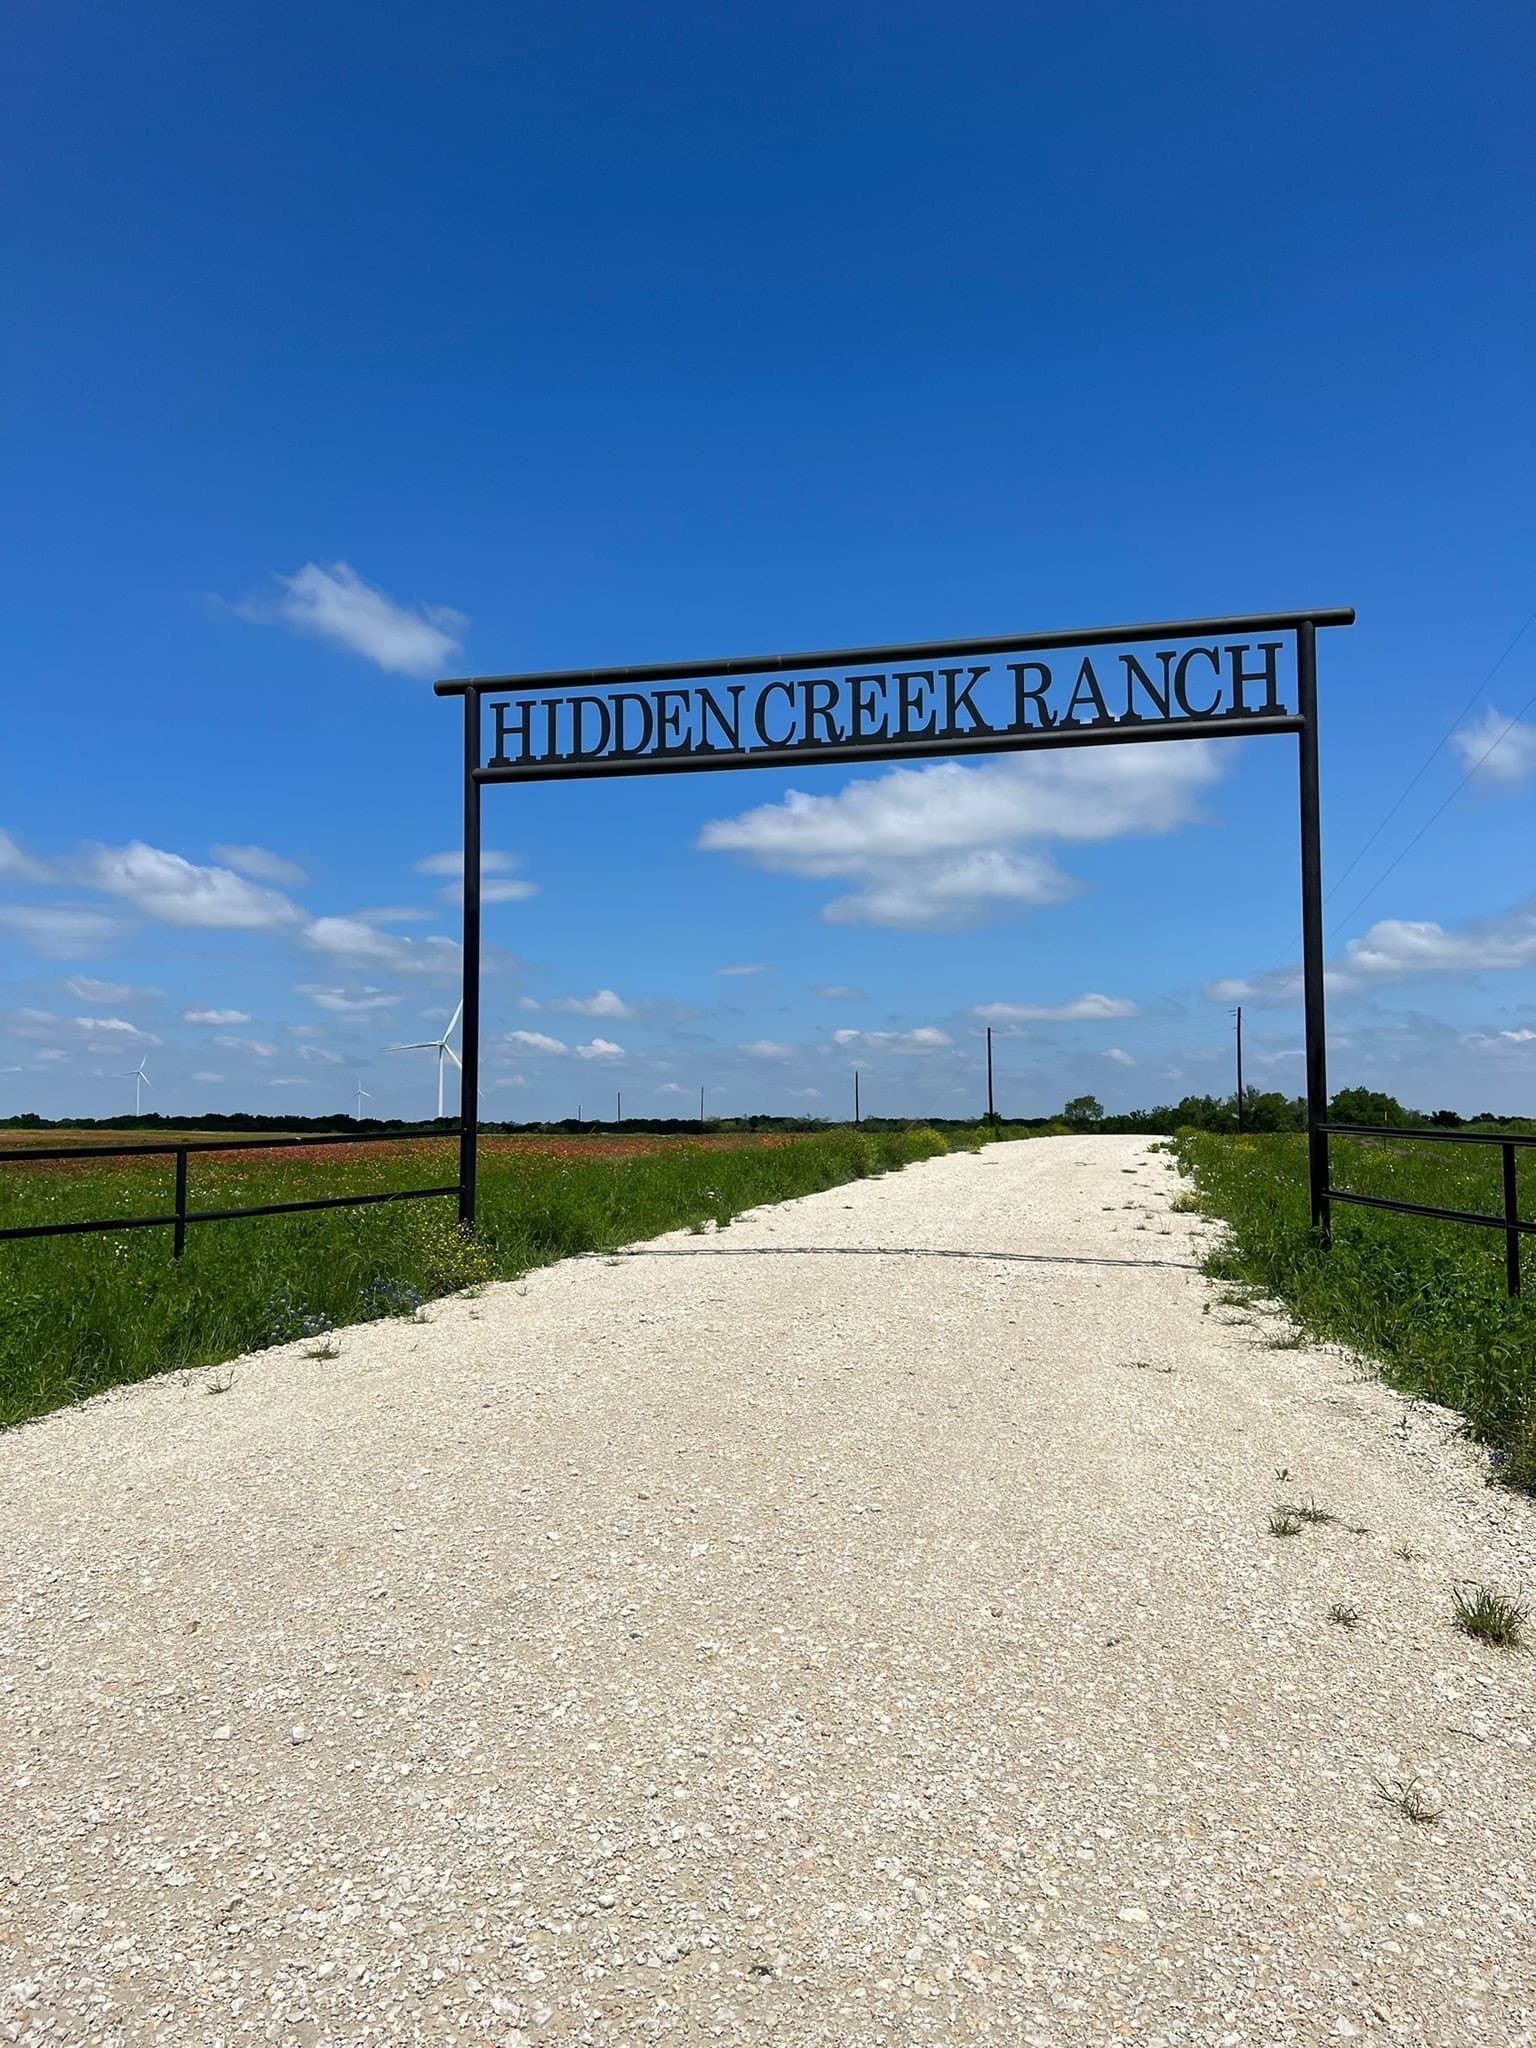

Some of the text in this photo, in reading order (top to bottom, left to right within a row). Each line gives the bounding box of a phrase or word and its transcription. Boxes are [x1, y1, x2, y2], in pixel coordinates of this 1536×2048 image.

[489, 641, 1287, 765] HIDDEN CREEK RANCH
